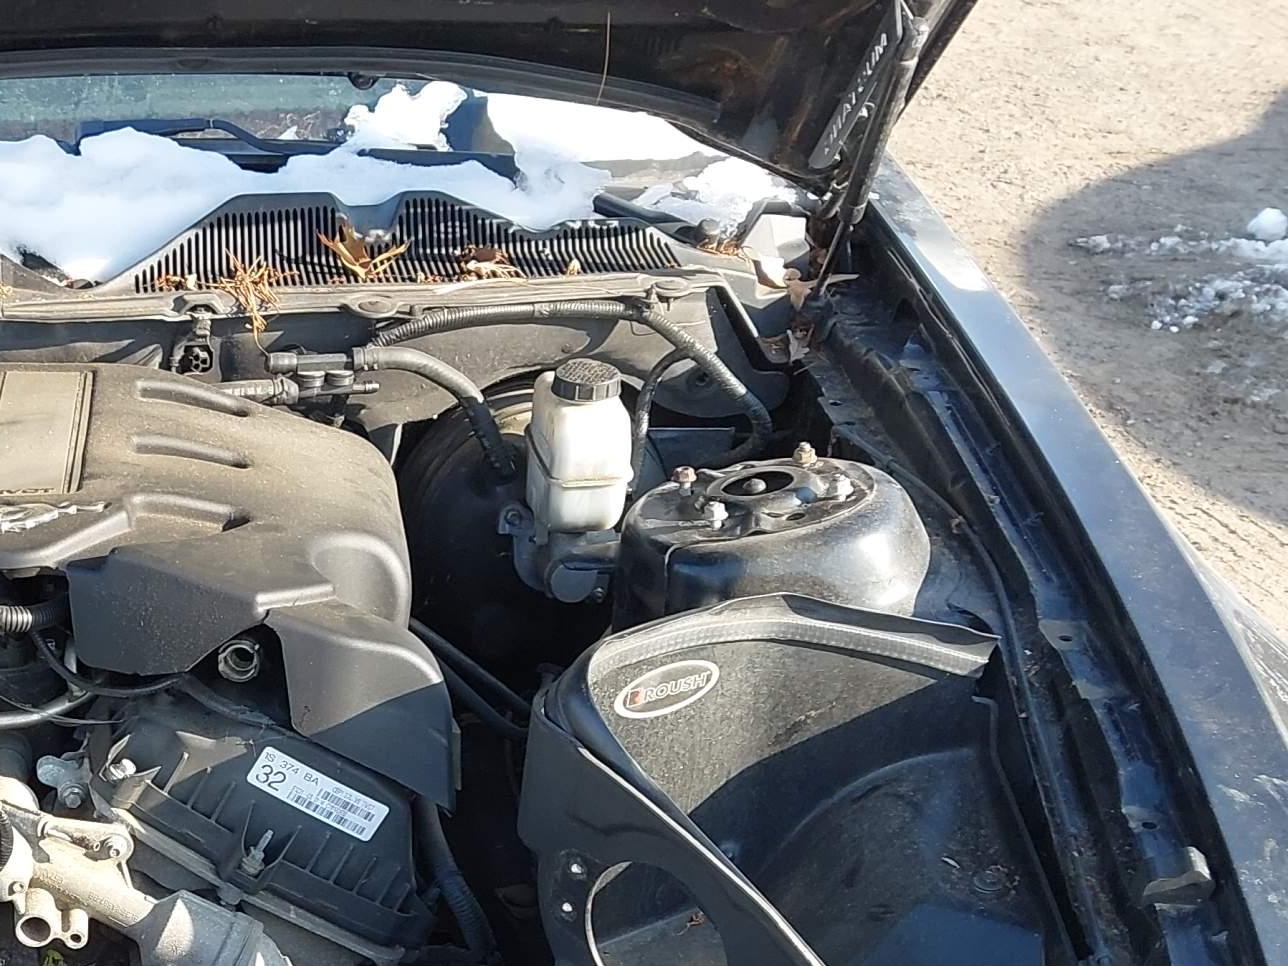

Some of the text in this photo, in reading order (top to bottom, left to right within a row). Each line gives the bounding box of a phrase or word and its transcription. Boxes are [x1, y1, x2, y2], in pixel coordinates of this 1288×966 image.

[642, 672, 707, 703] ROUSH
[255, 764, 287, 791] 32
[279, 760, 300, 774] 374
[303, 772, 319, 786] BA
